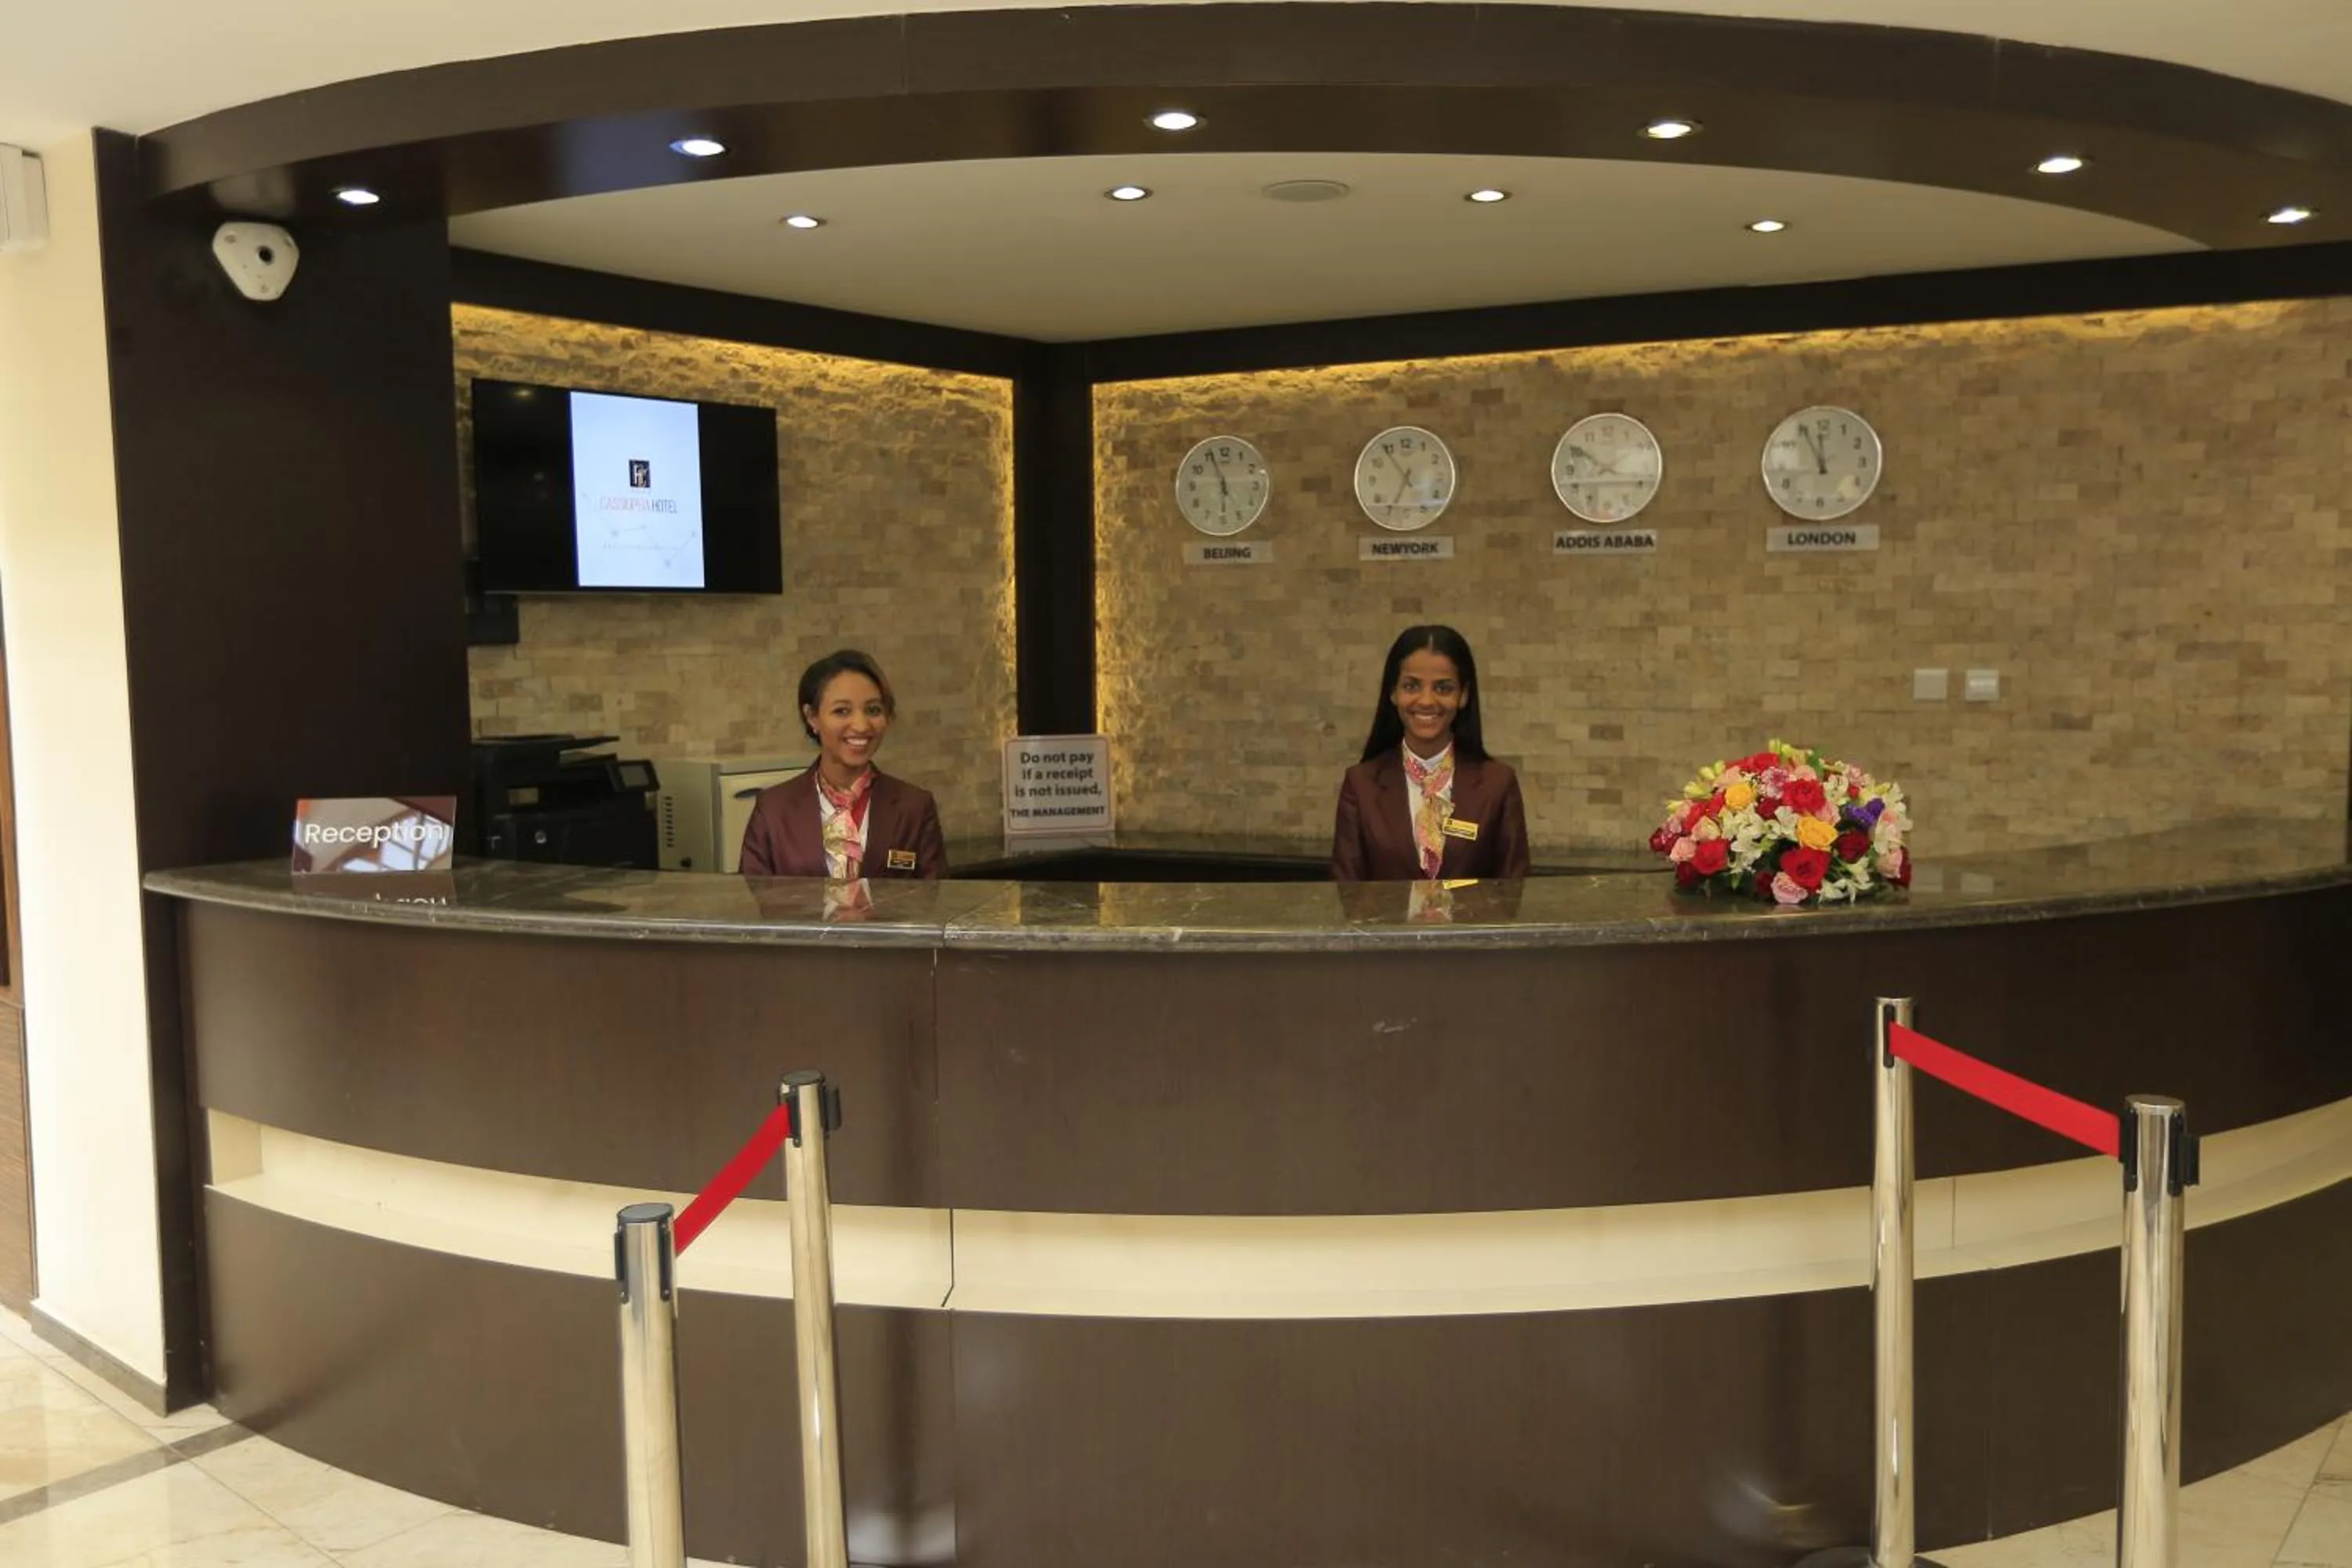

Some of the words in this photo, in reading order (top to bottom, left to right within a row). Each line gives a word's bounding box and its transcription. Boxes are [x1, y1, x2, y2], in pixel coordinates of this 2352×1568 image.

[1817, 419, 1830, 430] 12
[1841, 423, 1847, 436] 1
[1400, 438, 1411, 448] 12
[1584, 433, 1595, 442] 11
[1853, 437, 1861, 449] 2
[1219, 448, 1230, 457] 12
[1421, 441, 1426, 452] 1
[1239, 452, 1243, 461] 1
[1432, 454, 1439, 464] 2
[1858, 456, 1867, 468] 3
[1192, 465, 1203, 475] 10
[1248, 463, 1255, 474] 2
[1252, 481, 1260, 491] 3
[652, 499, 677, 514] HOTEL
[1817, 497, 1824, 508] 6
[1555, 535, 1600, 548] ADDIS
[1604, 533, 1654, 547] ABABA
[1788, 532, 1856, 546] LONDON
[1203, 546, 1251, 559] BEIJING
[1372, 542, 1439, 555] NEWYORK
[1020, 752, 1040, 764] Do
[1044, 753, 1066, 764] not
[1069, 753, 1094, 765] pay
[1035, 770, 1044, 780] a
[1046, 767, 1094, 782] receipt
[1015, 785, 1025, 797] is
[1029, 785, 1052, 797] not
[1010, 808, 1029, 818] THE
[1033, 806, 1105, 817] MANAGEMENT
[304, 822, 443, 848] Reception
